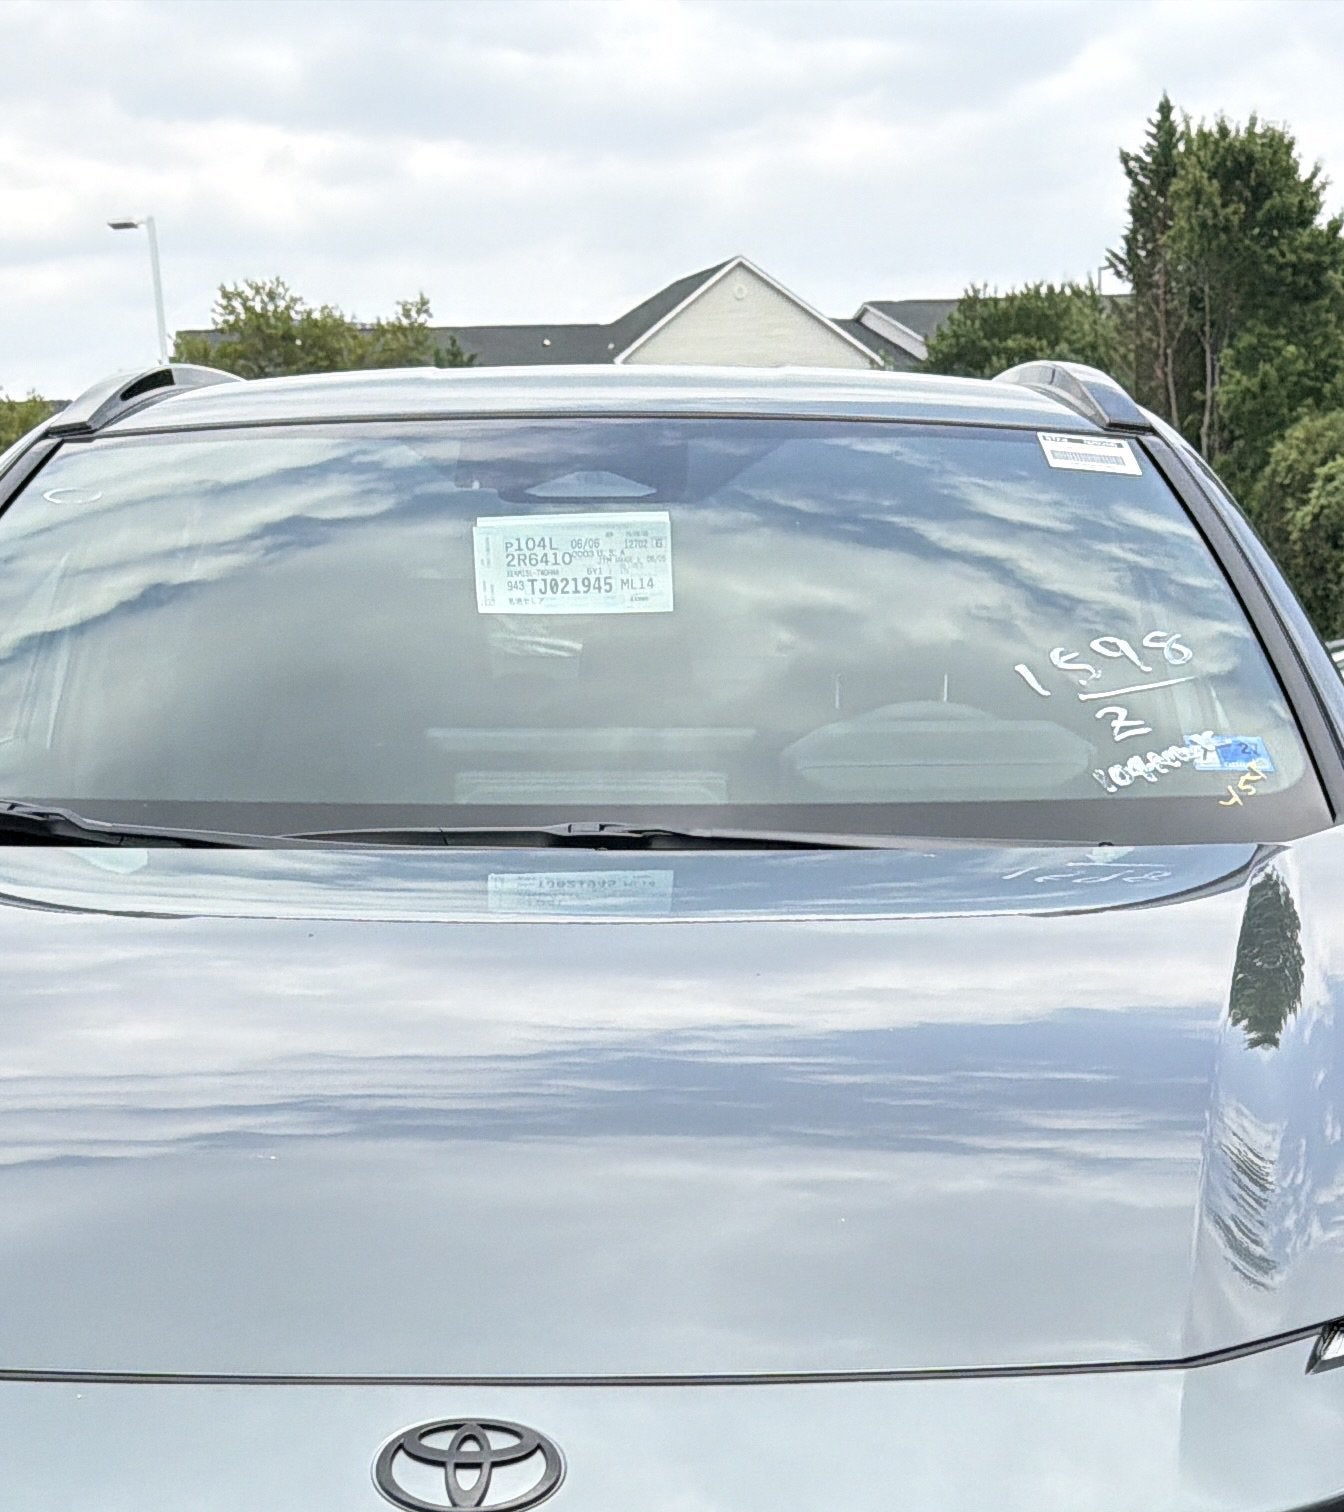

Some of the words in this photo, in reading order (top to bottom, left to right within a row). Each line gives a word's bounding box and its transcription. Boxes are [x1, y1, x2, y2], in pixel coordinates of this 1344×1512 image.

[505, 551, 573, 567] 2R6410
[507, 580, 525, 592] 943
[527, 576, 613, 596] TJ021945
[621, 577, 655, 591] ML14
[1014, 630, 1193, 696] 1598
